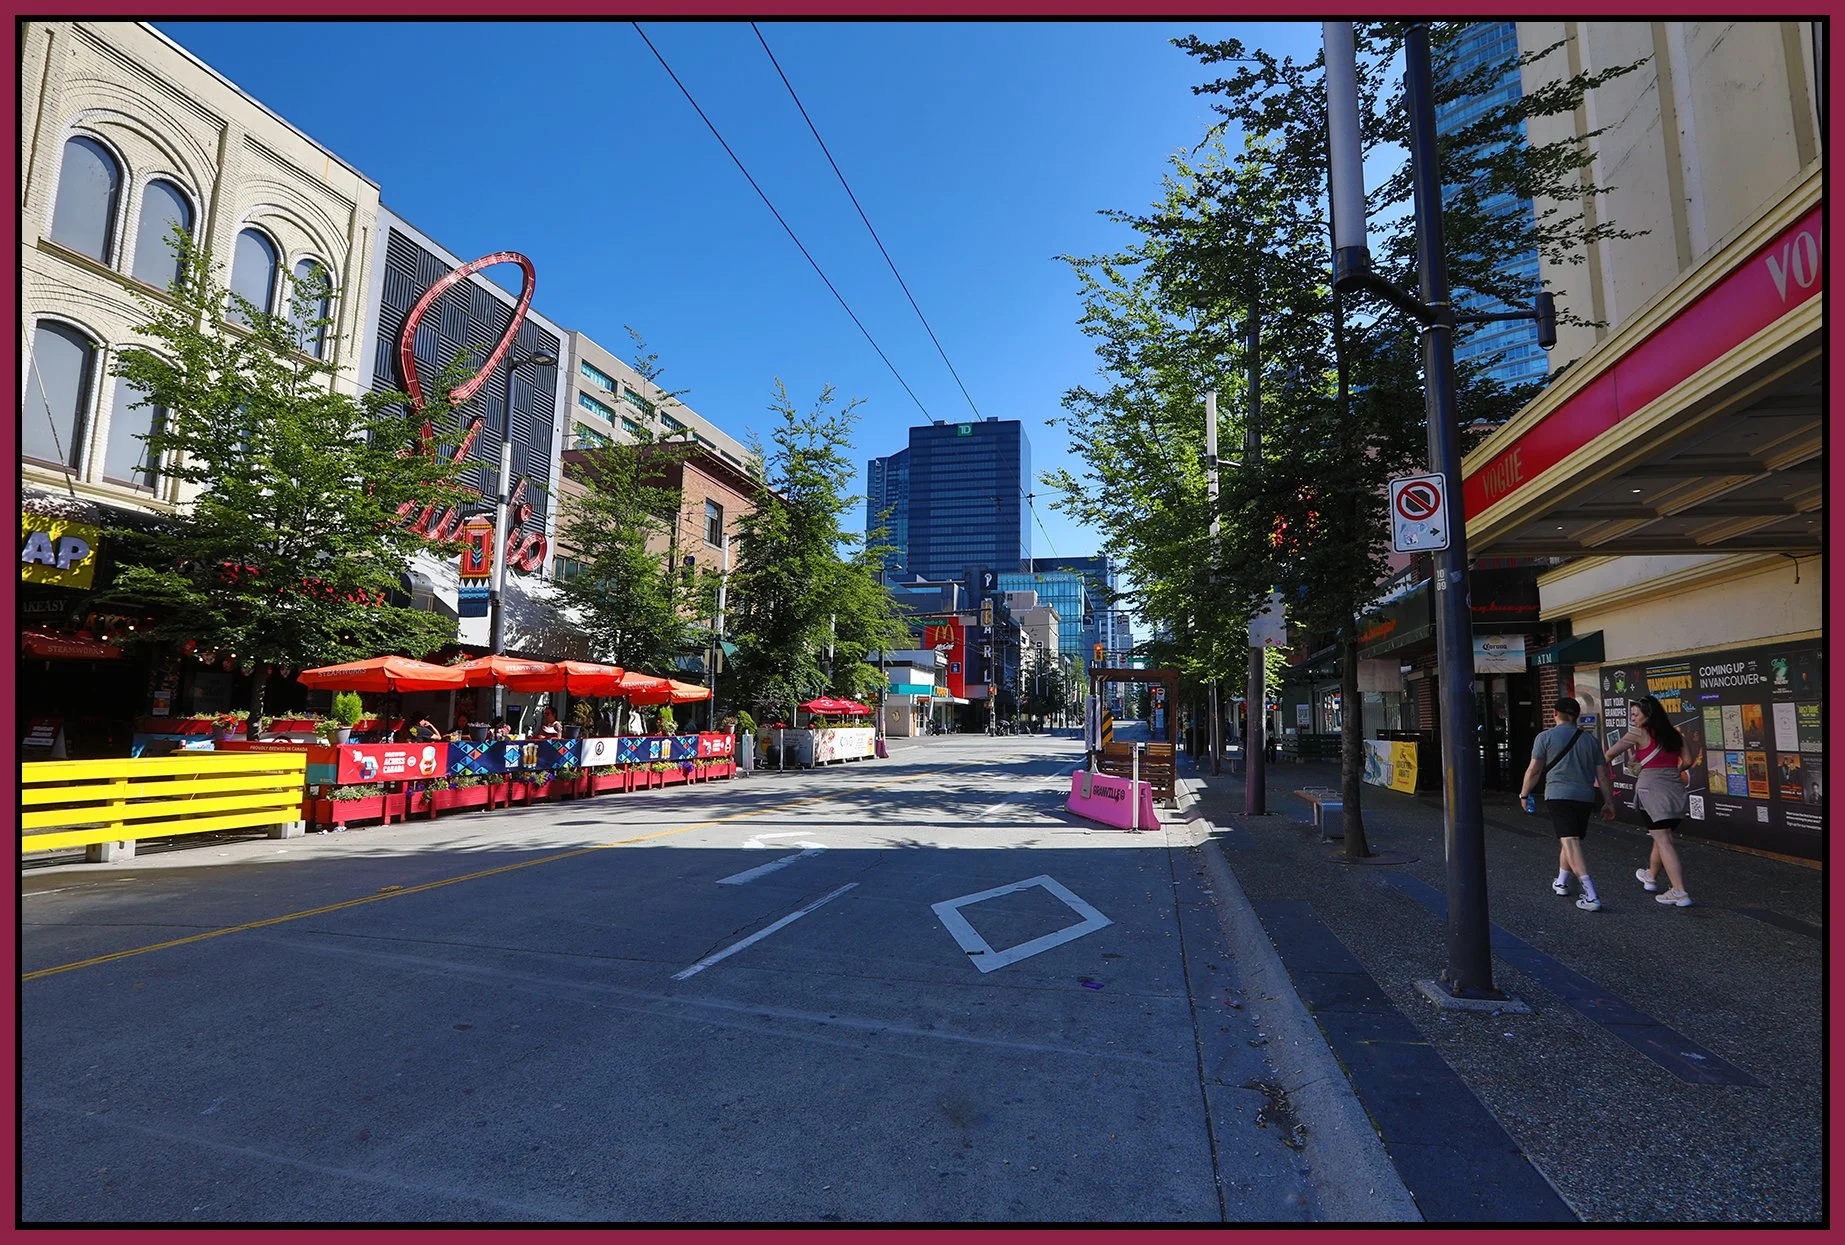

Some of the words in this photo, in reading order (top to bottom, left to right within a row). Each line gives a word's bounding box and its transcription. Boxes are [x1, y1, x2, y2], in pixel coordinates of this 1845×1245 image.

[1765, 231, 1822, 304] VO
[958, 425, 971, 435] TD
[1481, 446, 1524, 501] VOGUE
[1436, 569, 1445, 579] 10
[46, 644, 103, 656] STEAMWORKS
[1537, 653, 1553, 666] ATM
[317, 667, 368, 679] STEAMWORKS
[1699, 663, 1733, 677] COMING
[1733, 661, 1746, 674] UP
[1700, 678, 1709, 689] IN
[1708, 673, 1760, 688] VANCOUVER
[1604, 698, 1613, 707] NOT
[1613, 697, 1625, 706] YOUR
[1605, 718, 1616, 728] GOLF
[1616, 717, 1627, 728] CLUB
[382, 765, 405, 774] CANADA
[1093, 784, 1120, 800] GRANVILLE
